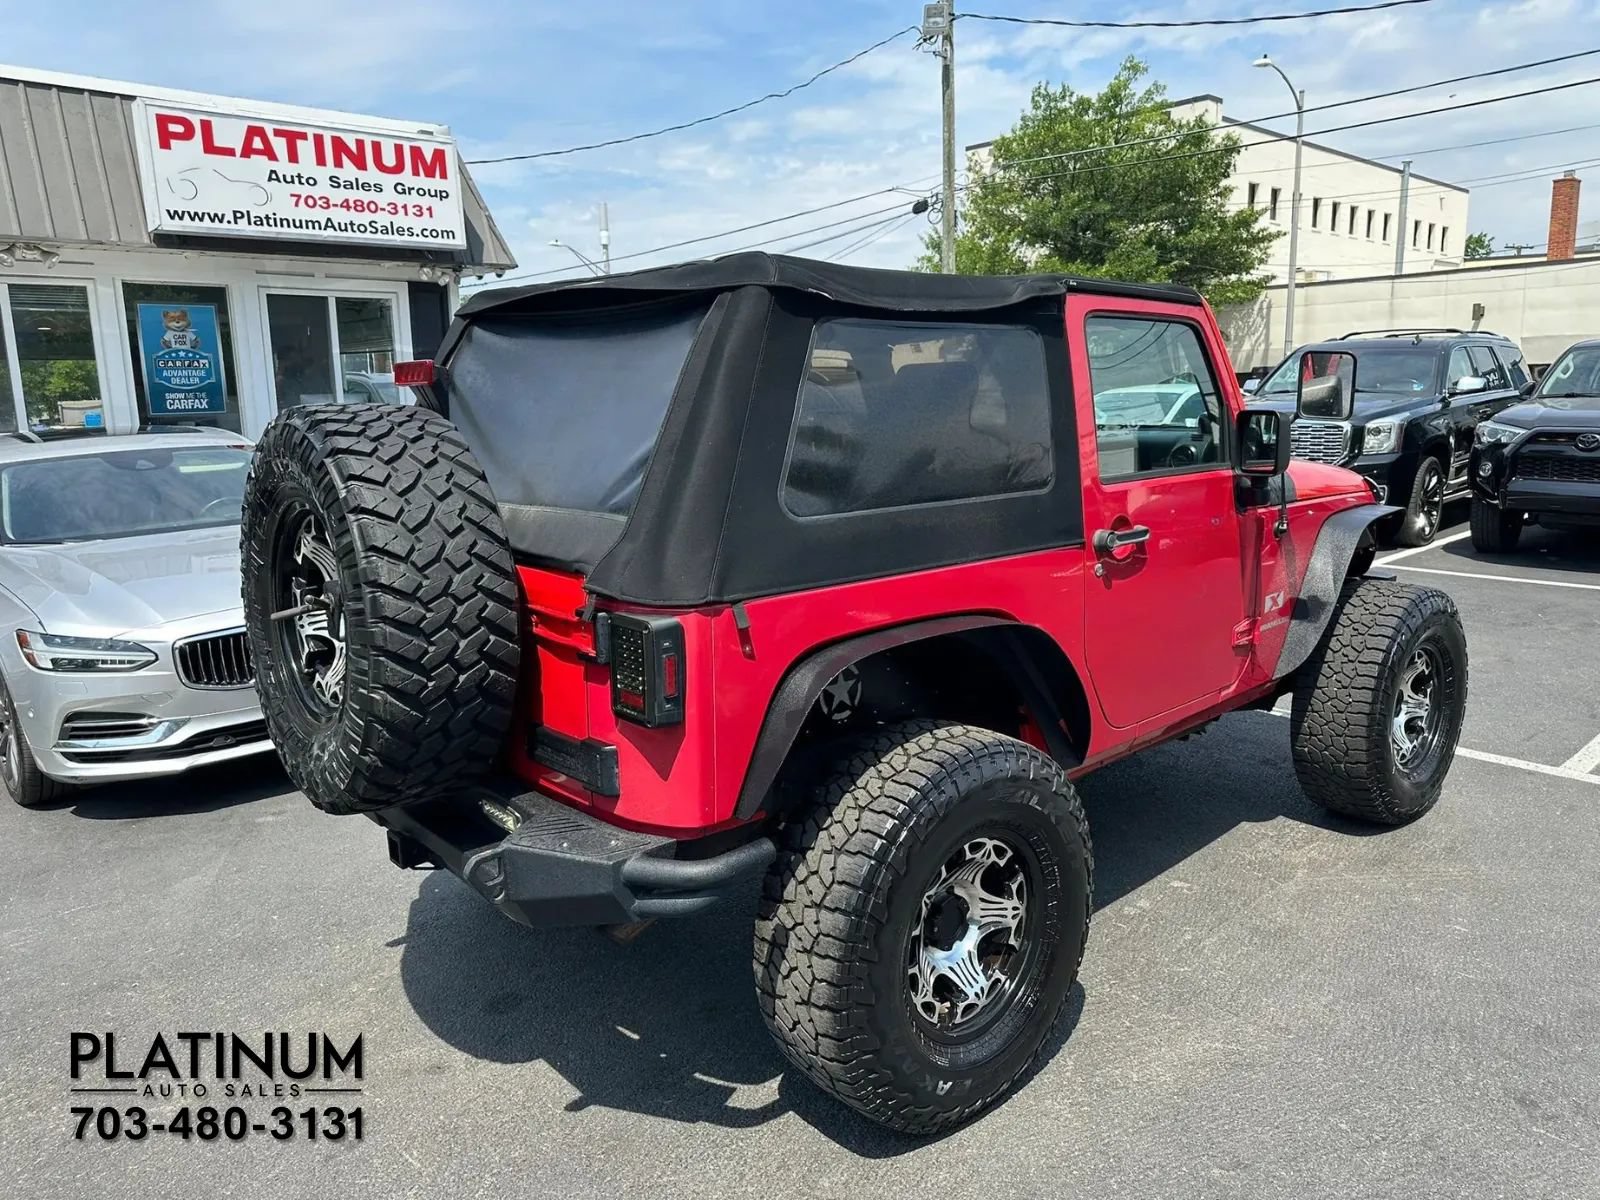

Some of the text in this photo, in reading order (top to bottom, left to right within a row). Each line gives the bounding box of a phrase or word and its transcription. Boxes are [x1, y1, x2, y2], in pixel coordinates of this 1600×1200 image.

[155, 113, 448, 180] PLATINUM
[267, 169, 449, 201] Auto Sales Group
[289, 193, 433, 218] 703-480-3131
[166, 208, 456, 240] www.PlatinumAutoSales.com
[158, 360, 208, 368] CARFAX
[163, 369, 207, 377] ADVANTAGE
[171, 377, 200, 385] DEALER
[165, 392, 185, 400] SHOW
[166, 399, 209, 410] CARFAX
